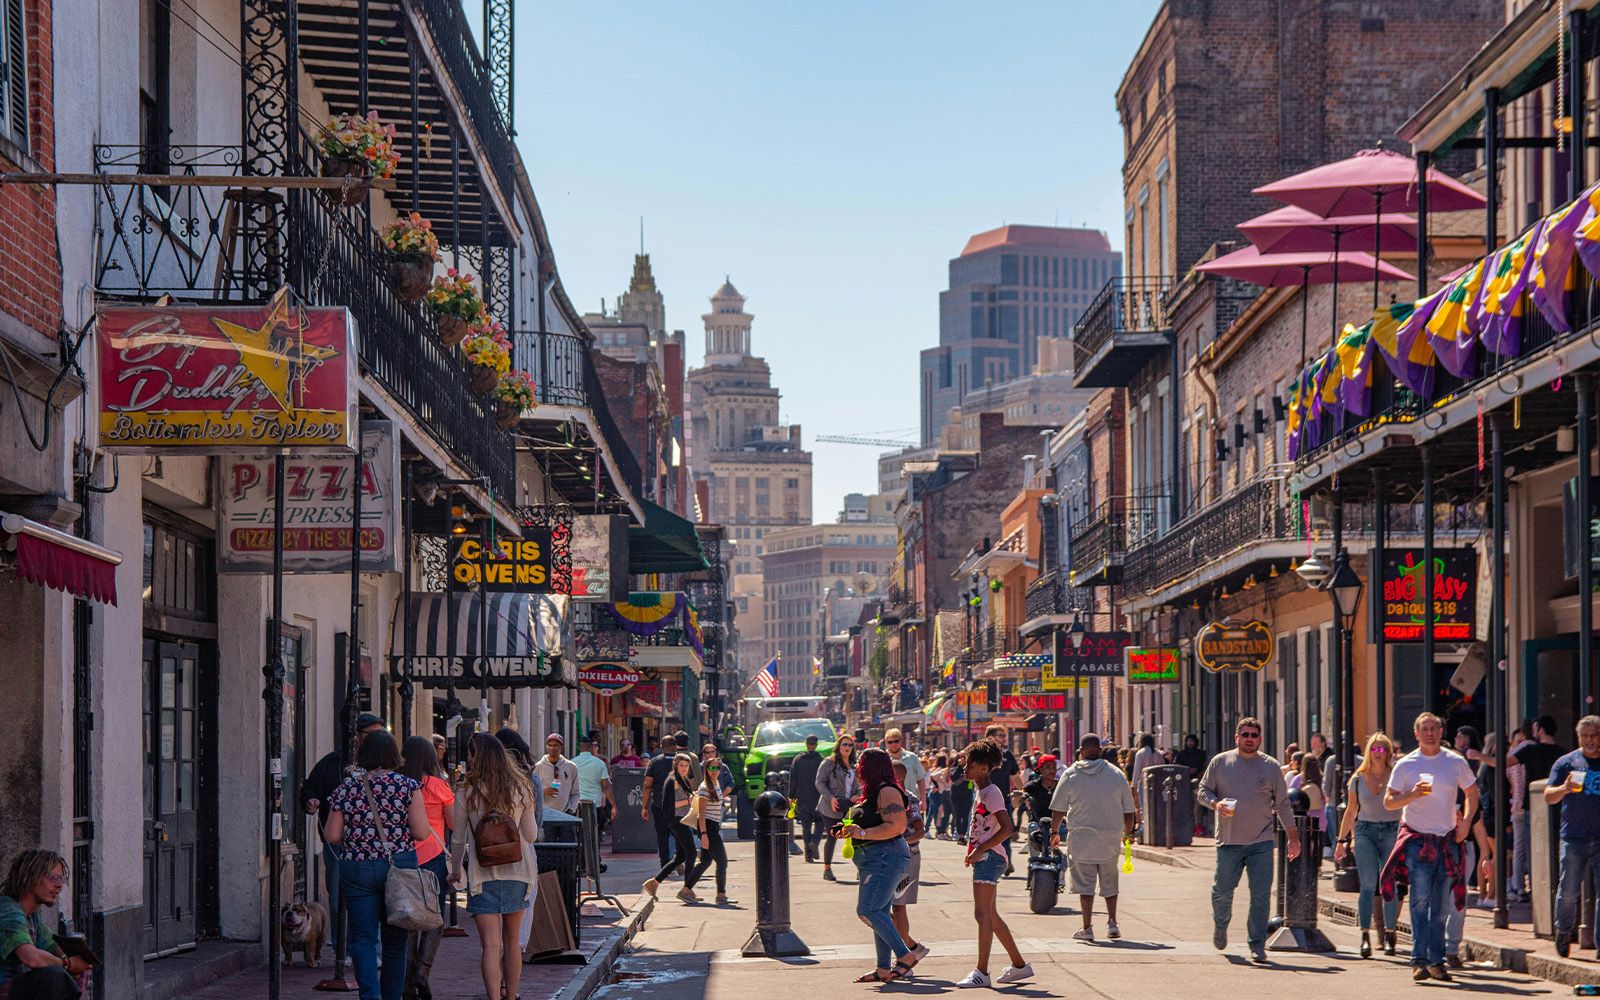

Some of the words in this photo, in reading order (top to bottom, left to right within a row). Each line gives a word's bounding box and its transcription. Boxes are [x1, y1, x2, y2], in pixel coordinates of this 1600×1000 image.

[107, 363, 270, 420] Daddy's
[107, 412, 246, 441] Bottomless
[249, 412, 343, 443] Topless
[257, 506, 354, 524] EPRESS
[306, 529, 334, 549] THE
[337, 530, 380, 549] SLCE
[461, 539, 541, 561] CRIS
[1383, 574, 1417, 601] BIG
[1421, 573, 1468, 601] ASY
[1203, 640, 1269, 655] BANDSTAND
[473, 656, 552, 678] OWENS
[578, 671, 640, 683] DIXIELAND
